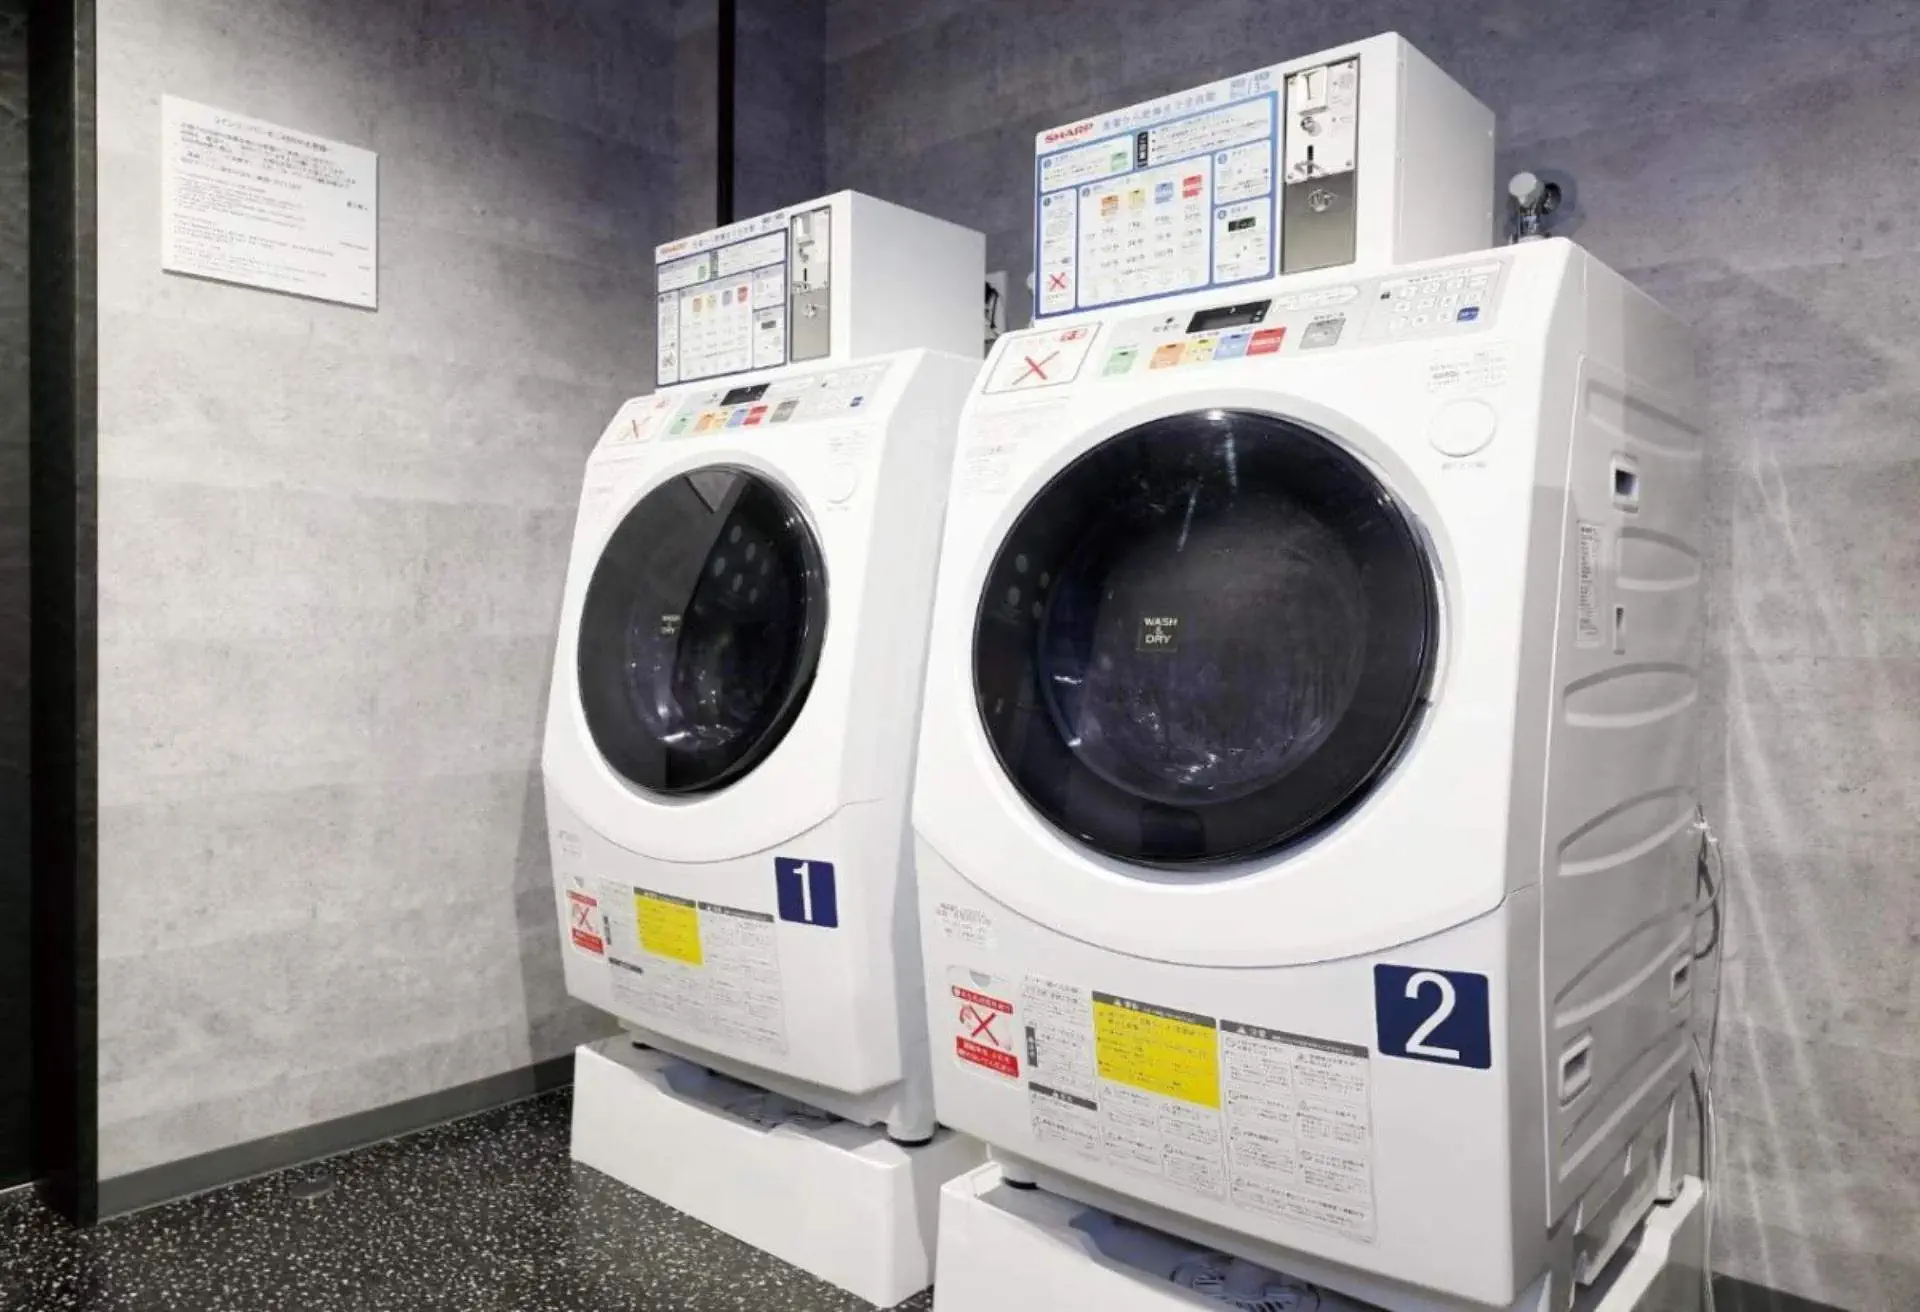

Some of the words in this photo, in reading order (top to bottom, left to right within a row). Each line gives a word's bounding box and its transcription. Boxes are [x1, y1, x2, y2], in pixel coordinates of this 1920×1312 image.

[1045, 122, 1094, 143] SHARP
[1144, 617, 1179, 626] WASH
[1145, 634, 1173, 644] DRY
[793, 862, 812, 921] 1
[1405, 971, 1460, 1060] 2
